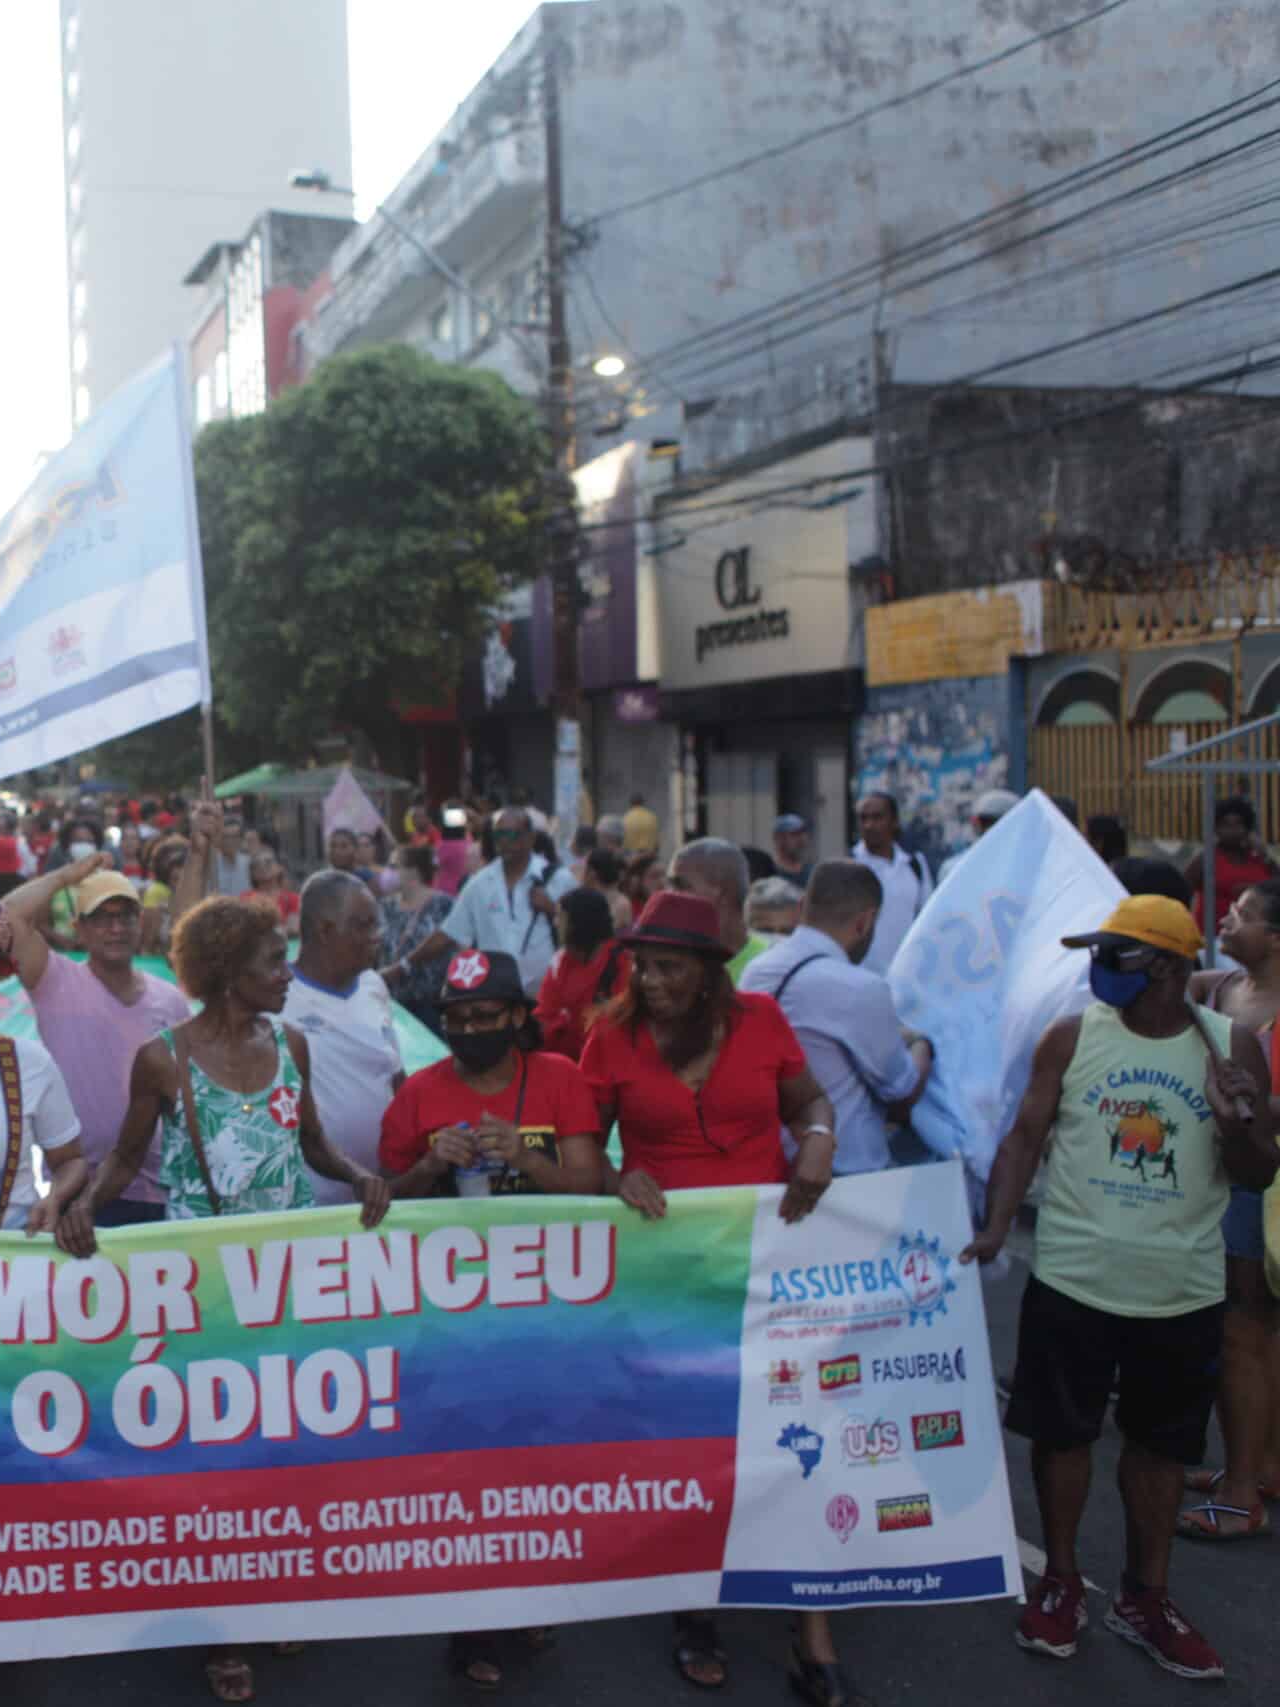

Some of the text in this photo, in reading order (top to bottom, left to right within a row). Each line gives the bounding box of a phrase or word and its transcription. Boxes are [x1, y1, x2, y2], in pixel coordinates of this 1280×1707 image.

[696, 607, 791, 664] presentes
[1106, 1067, 1214, 1124] CAMINHADA
[220, 1220, 617, 1329] VENCEU
[769, 1257, 903, 1304] ASSUFBA
[872, 1352, 951, 1384] FASUBRA
[12, 1337, 401, 1458] O ÓDIO!
[175, 1505, 313, 1544] PÚBLICA,
[320, 1491, 475, 1532] GRATUITA,
[481, 1473, 715, 1520] DEMOCRÁTICA,
[75, 1562, 92, 1591] E
[100, 1546, 316, 1589] SOCIALMENTE
[324, 1529, 584, 1575] COMPROMETIDA!
[791, 1572, 943, 1596] www.assufba.org.br
